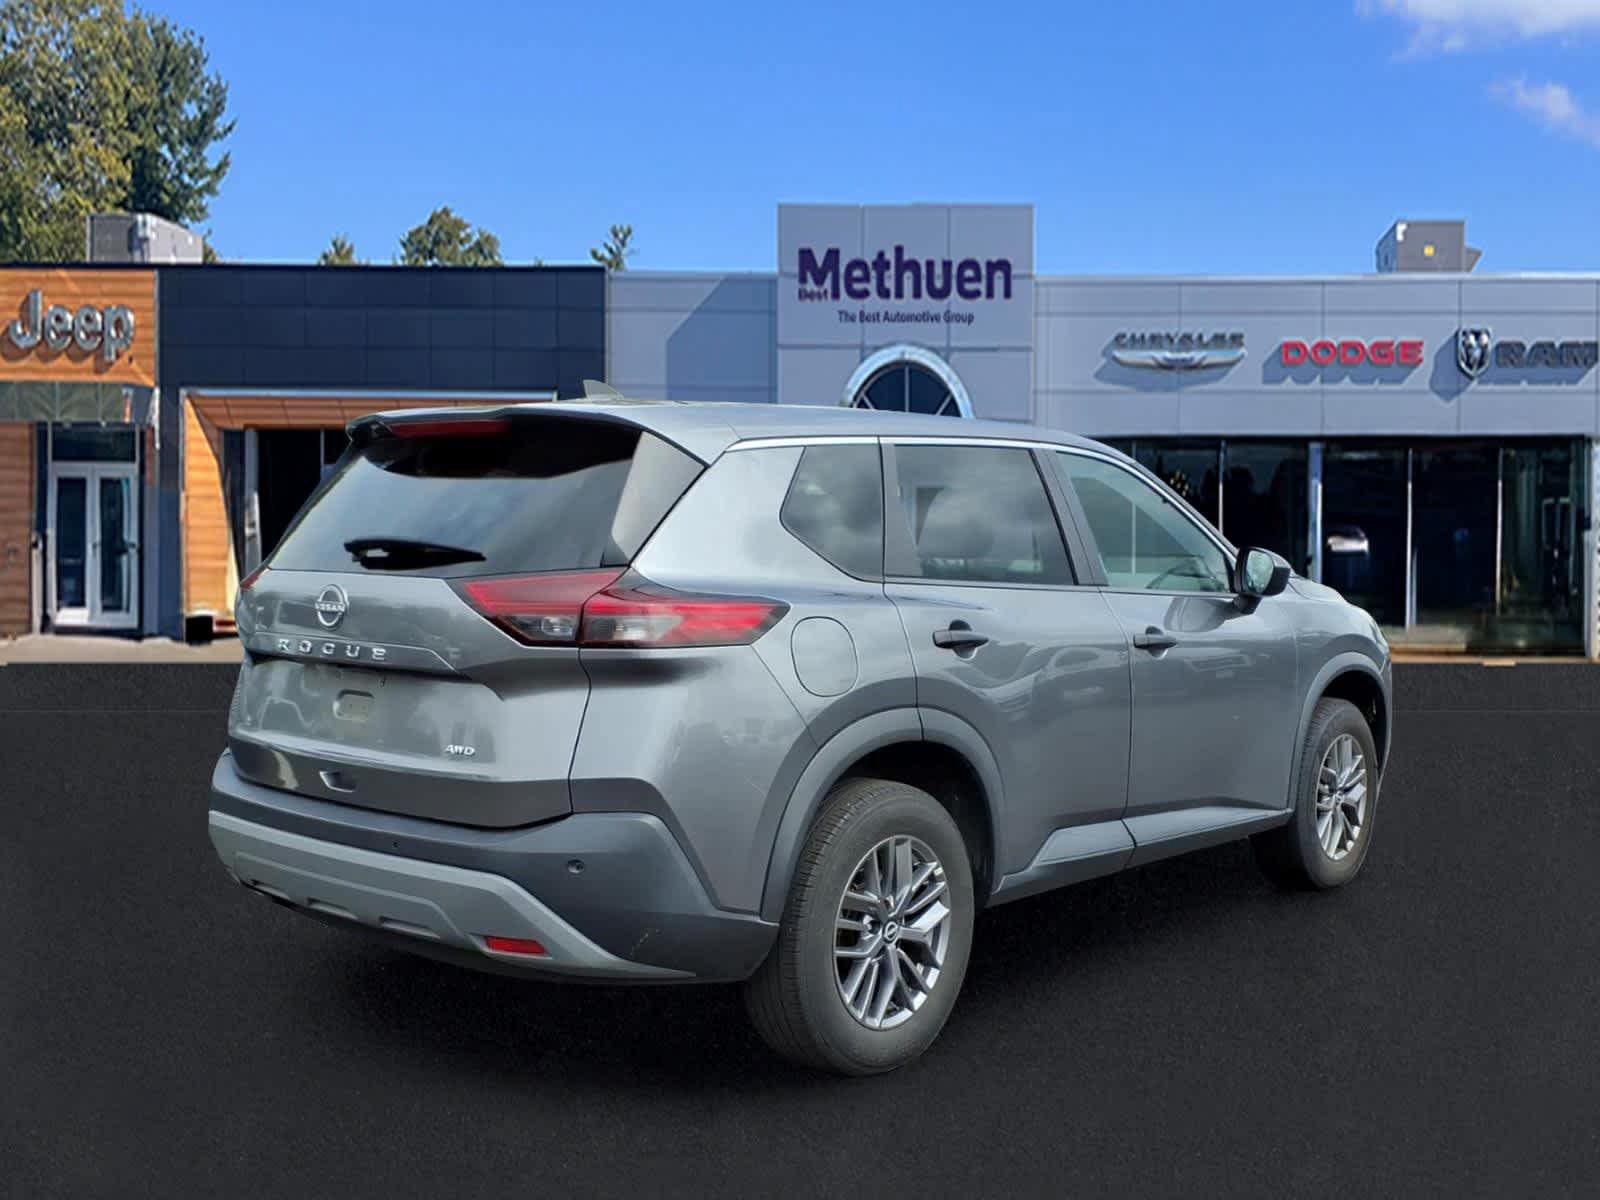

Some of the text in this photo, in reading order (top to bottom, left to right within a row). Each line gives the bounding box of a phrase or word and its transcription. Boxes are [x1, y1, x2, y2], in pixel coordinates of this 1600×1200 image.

[798, 244, 1012, 300] Methuen
[9, 288, 134, 361] Jeep
[838, 310, 975, 327] The Best Automotive Group
[1112, 331, 1246, 349] CHRYSLER
[1282, 340, 1424, 365] DODGE
[1495, 340, 1599, 368] RAM
[277, 637, 388, 661] ROGUE
[445, 744, 476, 756] AWD
